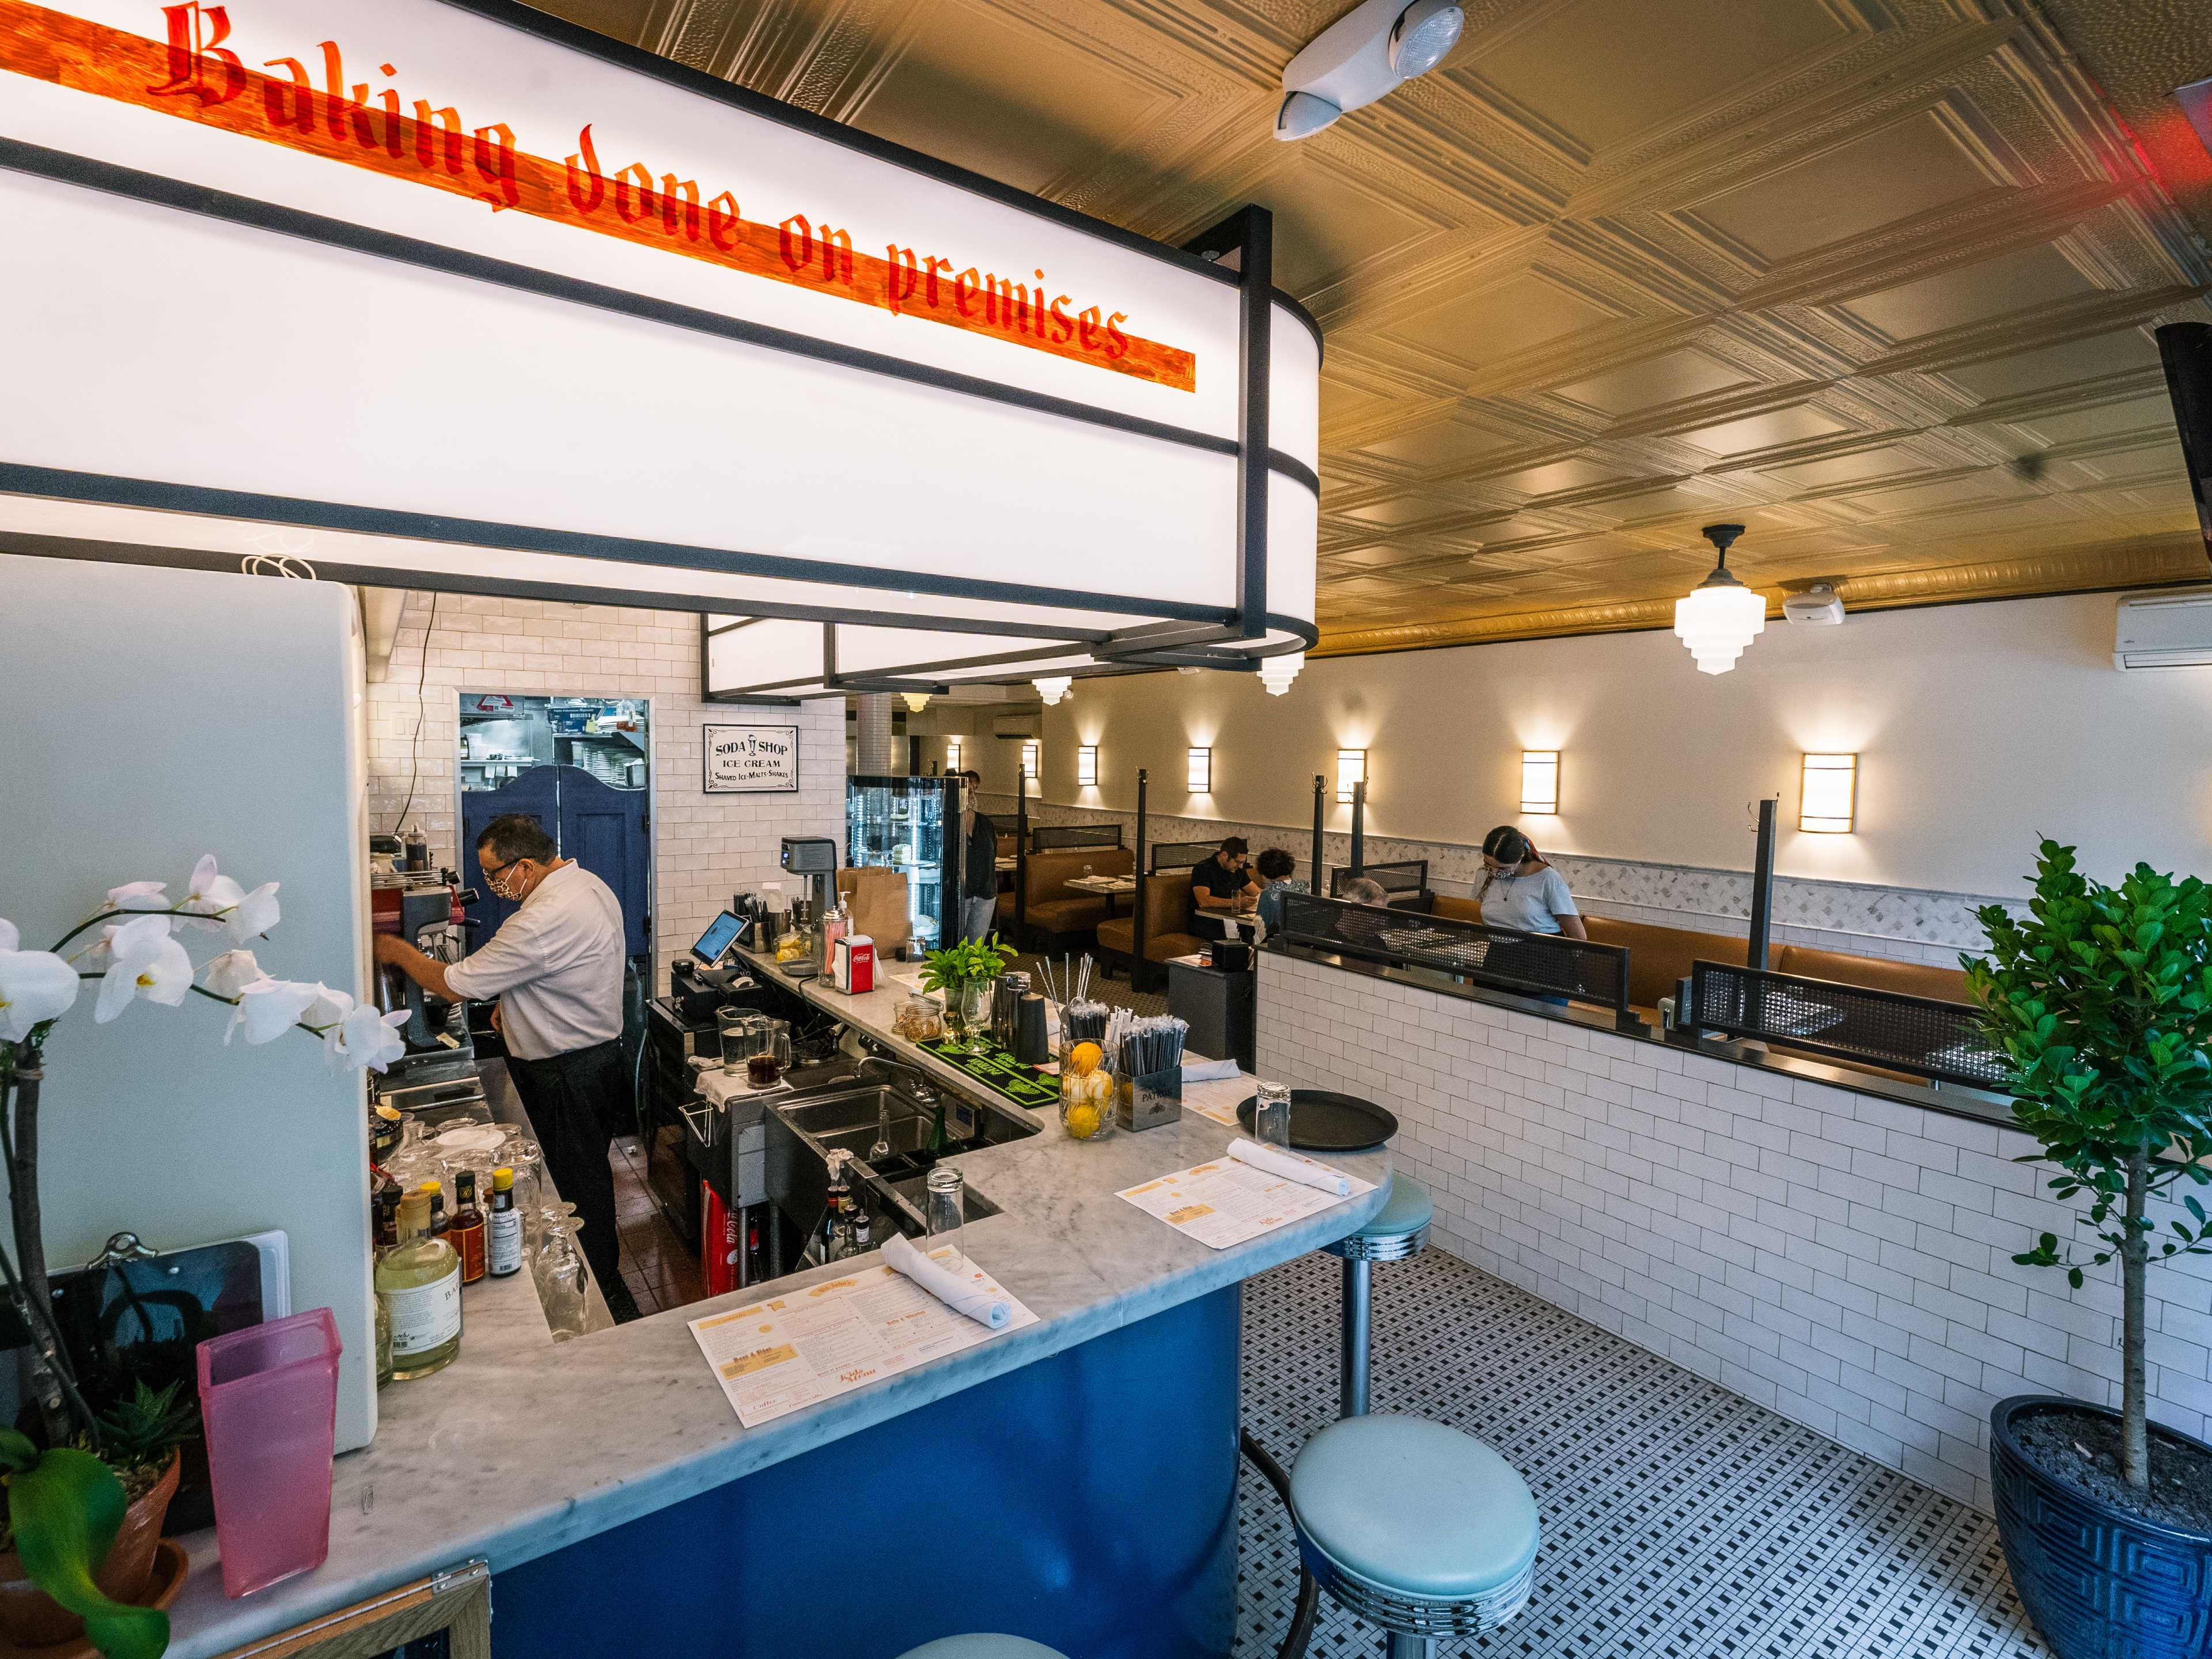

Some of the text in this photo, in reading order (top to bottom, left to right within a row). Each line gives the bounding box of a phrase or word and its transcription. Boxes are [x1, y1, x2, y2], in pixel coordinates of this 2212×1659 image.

[146, 1, 1129, 361] Baking done on premises
[715, 741, 788, 756] SODA SHOP
[722, 760, 781, 768] ICE CREAM
[444, 1282, 460, 1301] BA
